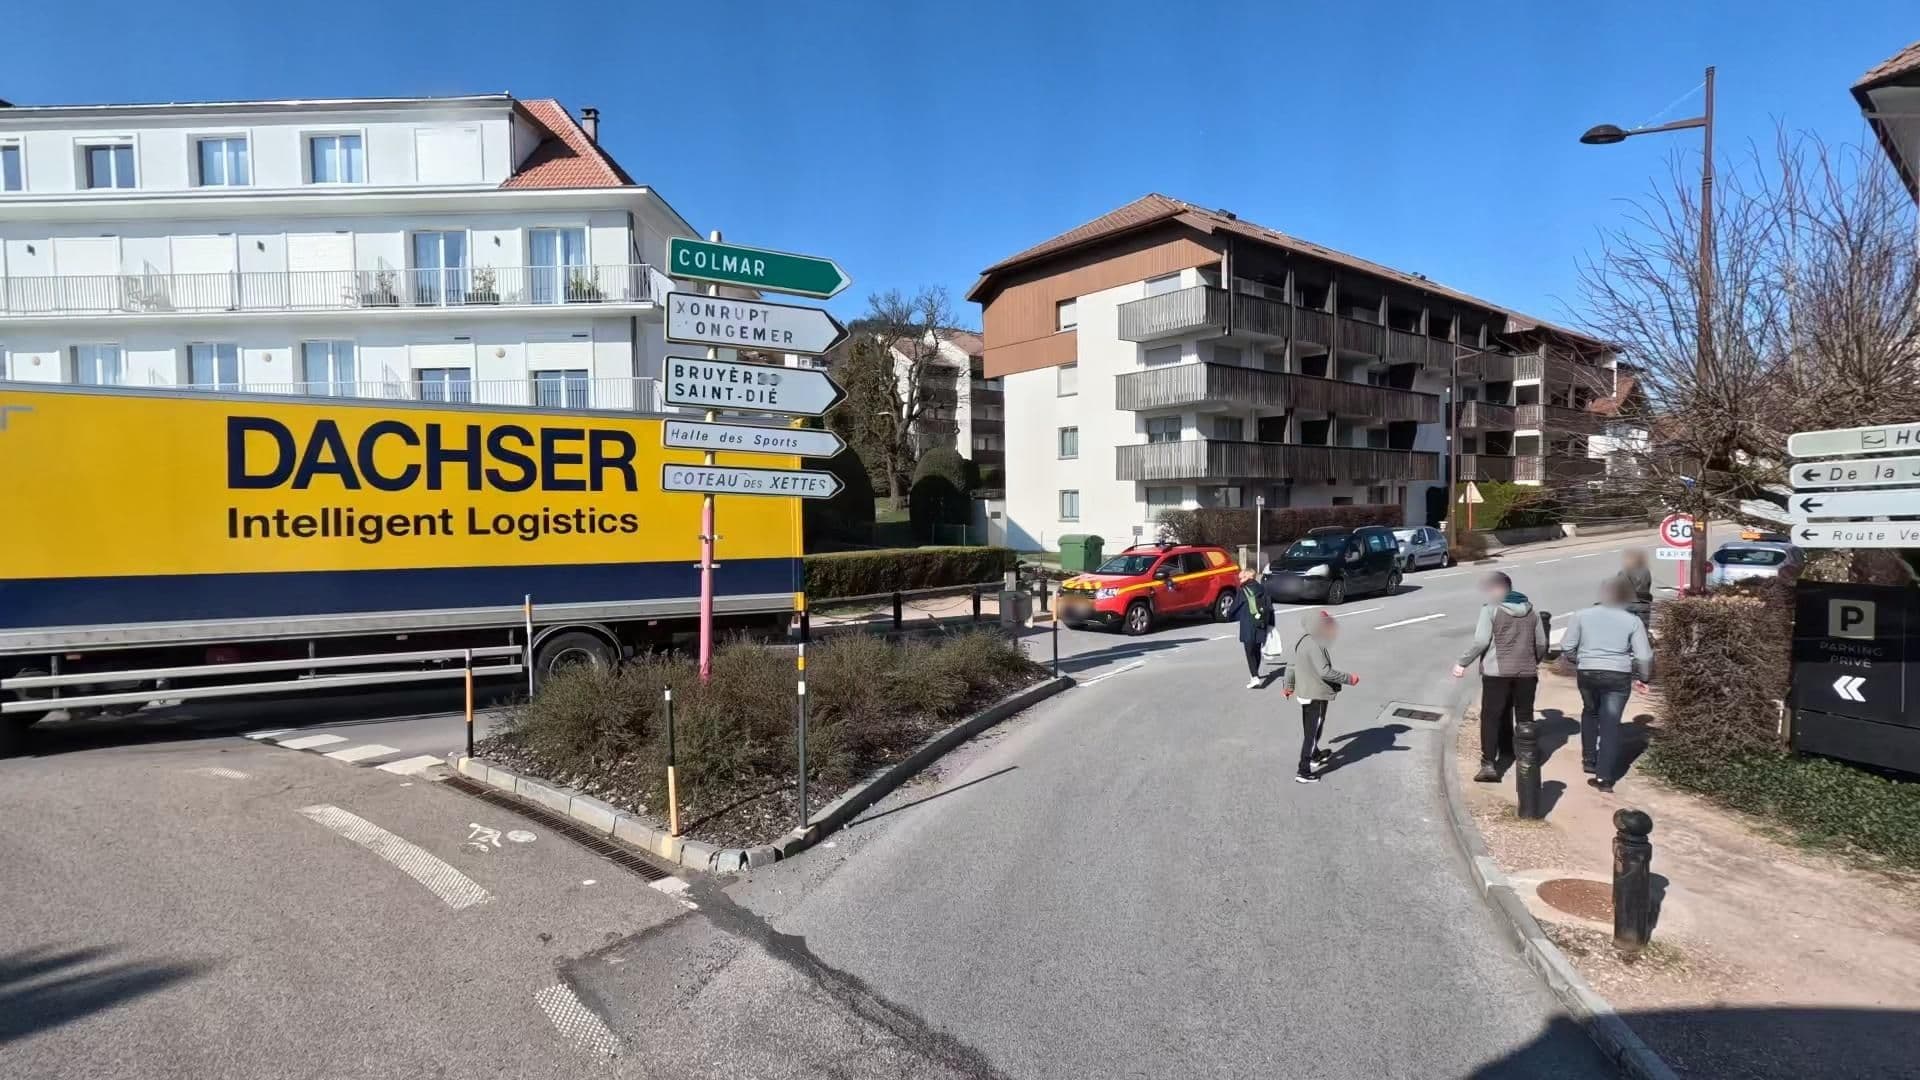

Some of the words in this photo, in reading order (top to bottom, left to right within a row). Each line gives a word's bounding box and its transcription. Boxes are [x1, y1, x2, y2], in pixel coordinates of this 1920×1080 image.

[678, 249, 766, 278] COLMAR
[676, 300, 769, 325] XONRUPT
[677, 320, 793, 344] ONGEMER
[674, 383, 778, 405] SAINT-DIÉ
[671, 428, 709, 441] Halle
[719, 433, 743, 444] des
[753, 434, 799, 448] Sports
[227, 416, 638, 492] DACHSER
[672, 471, 738, 488] COTEAU
[743, 479, 763, 489] DES
[769, 475, 826, 491] XETTES
[1829, 467, 1857, 481] De
[1874, 464, 1896, 480] la
[228, 507, 454, 544] Intelligent
[468, 506, 639, 541] Logistics
[1669, 524, 1693, 538] 50
[1832, 530, 1886, 541] Route
[1900, 528, 1920, 541] Ve
[1840, 605, 1865, 632] P
[1819, 640, 1883, 657] PARKING
